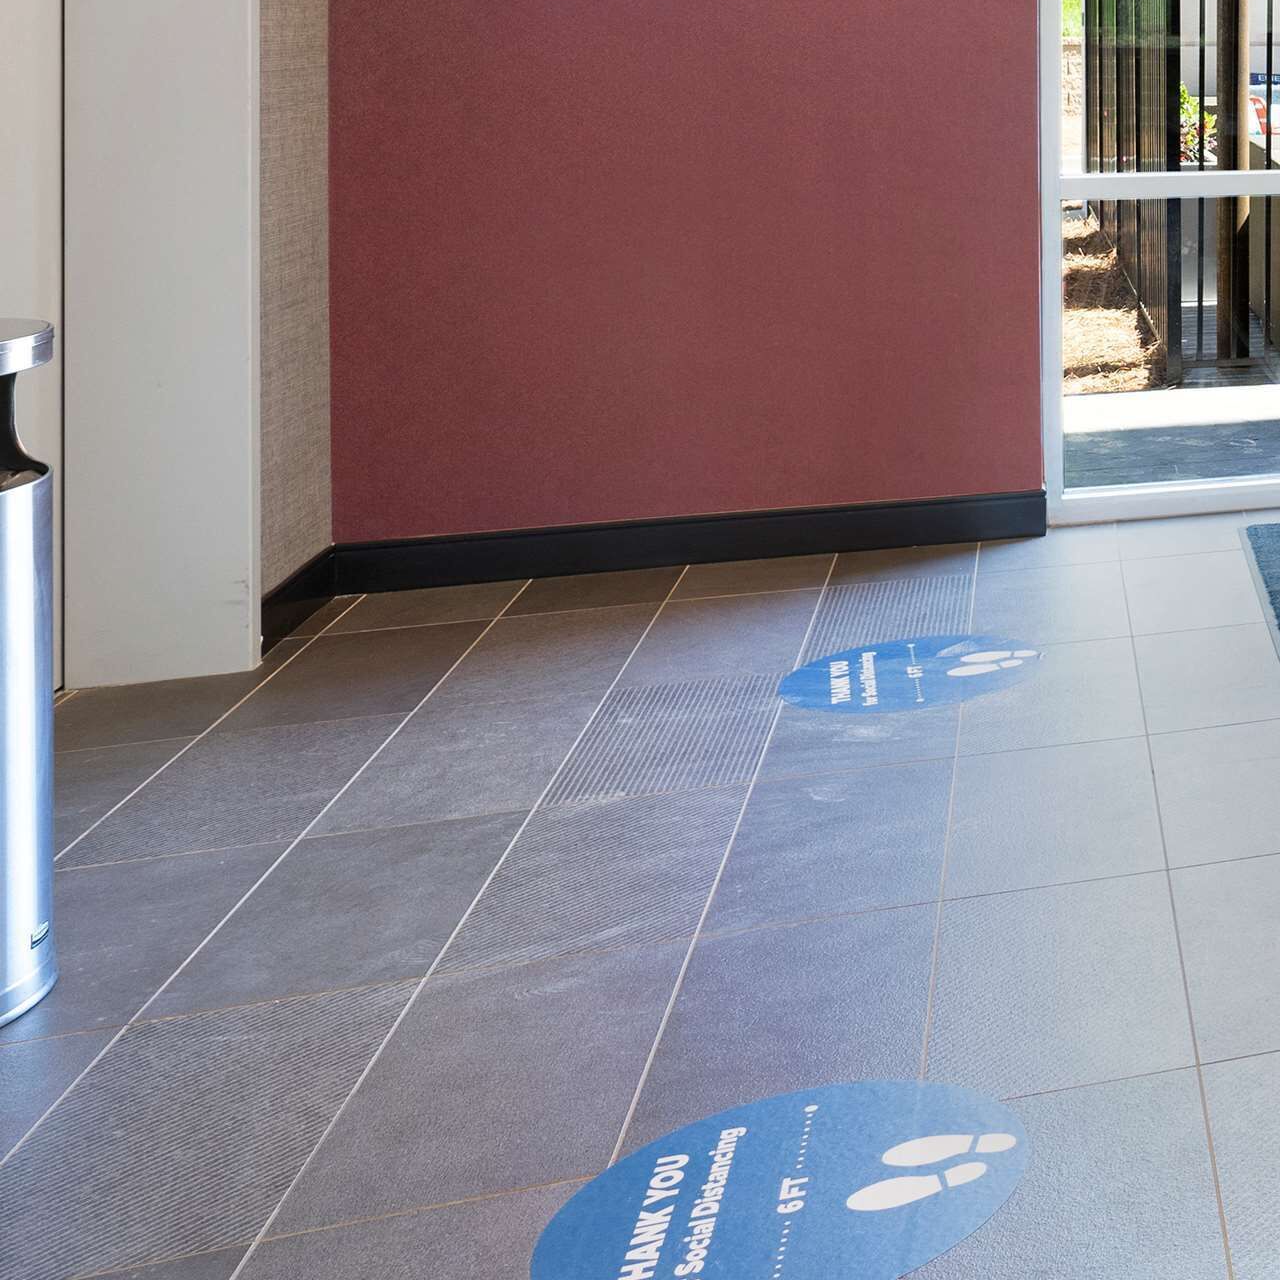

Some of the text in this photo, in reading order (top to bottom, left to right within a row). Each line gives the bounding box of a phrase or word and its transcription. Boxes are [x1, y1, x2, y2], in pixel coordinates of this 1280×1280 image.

[829, 660, 851, 705] THANK YOU
[690, 1126, 748, 1218] Distancing
[776, 1175, 809, 1214] 6 FT
[617, 1153, 690, 1280] HANK YOU
[673, 1216, 718, 1276] Social
